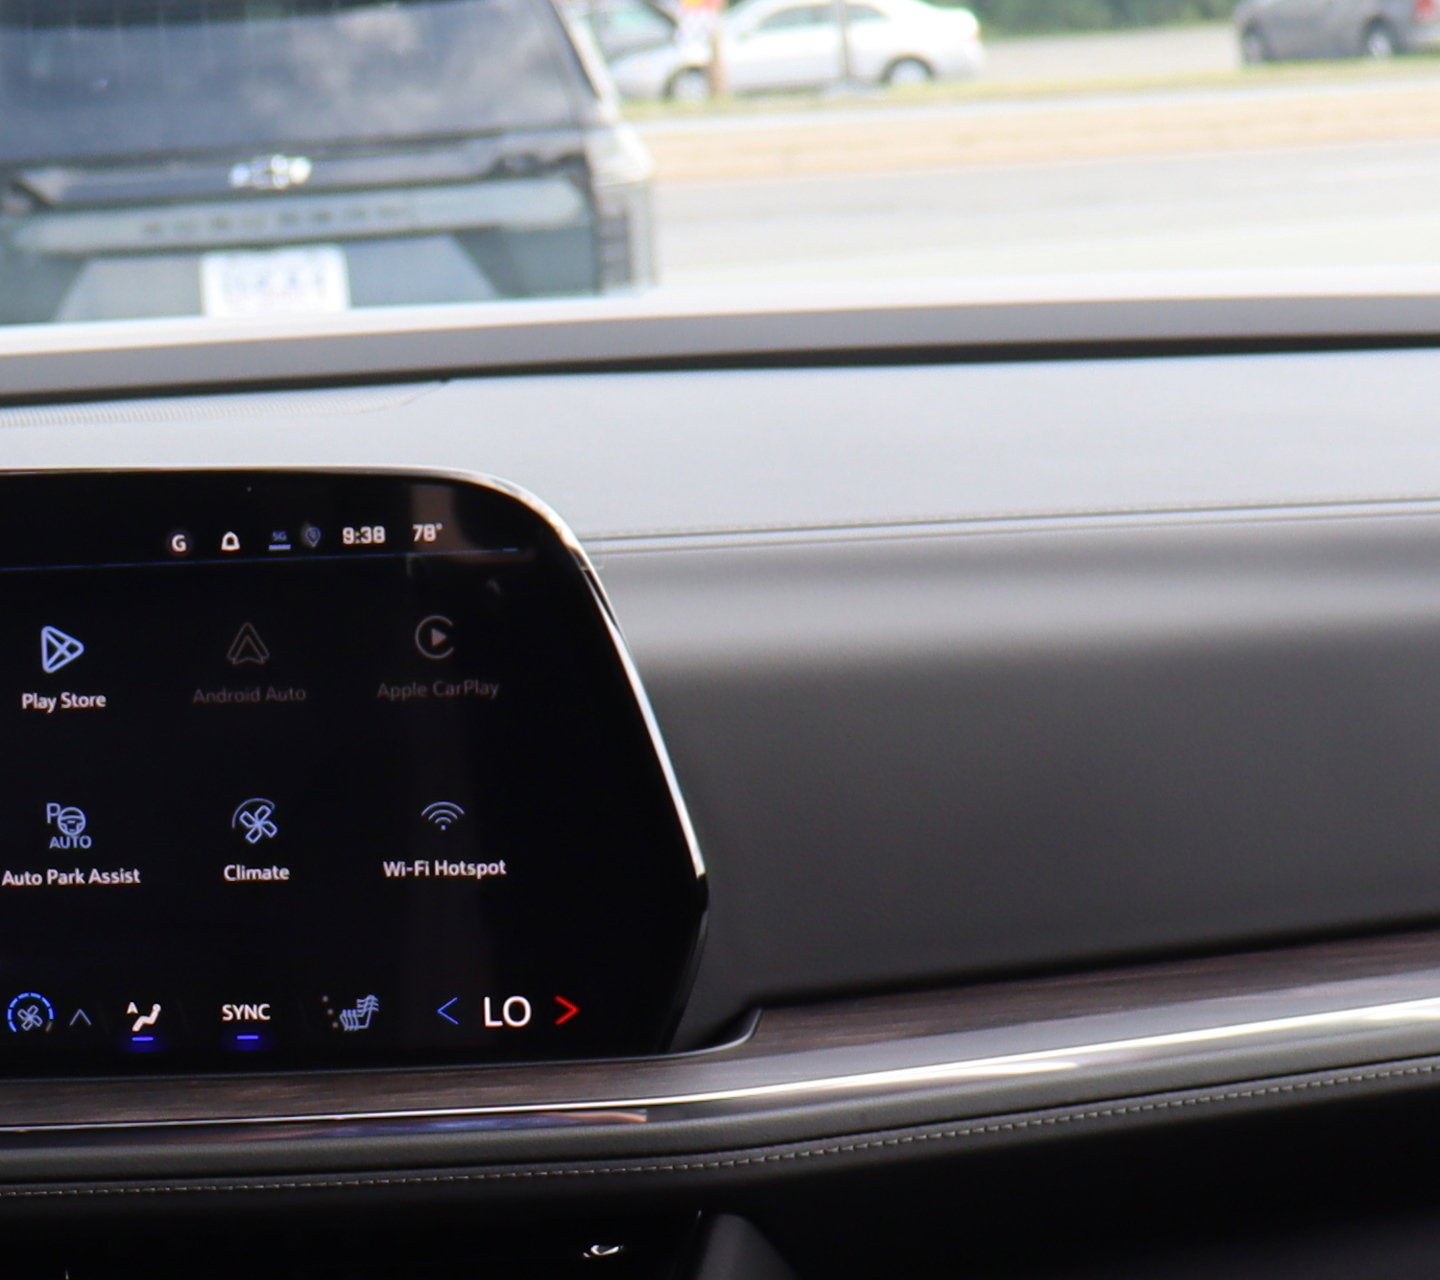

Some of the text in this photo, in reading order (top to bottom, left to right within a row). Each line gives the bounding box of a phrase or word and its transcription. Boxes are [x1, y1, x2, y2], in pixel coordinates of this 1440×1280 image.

[342, 525, 386, 544] 9:38
[412, 523, 443, 542] 78°
[192, 683, 308, 704] Android Auto
[376, 678, 500, 702] Apple CarPlay
[21, 690, 106, 712] Play Store
[48, 834, 92, 850] AUTO
[1, 866, 141, 887] Auto Park Assist
[223, 862, 290, 882] Climate
[382, 857, 507, 880] Wi-Fi Hotspot
[221, 1003, 271, 1022] SYNC
[483, 997, 532, 1028] LO
